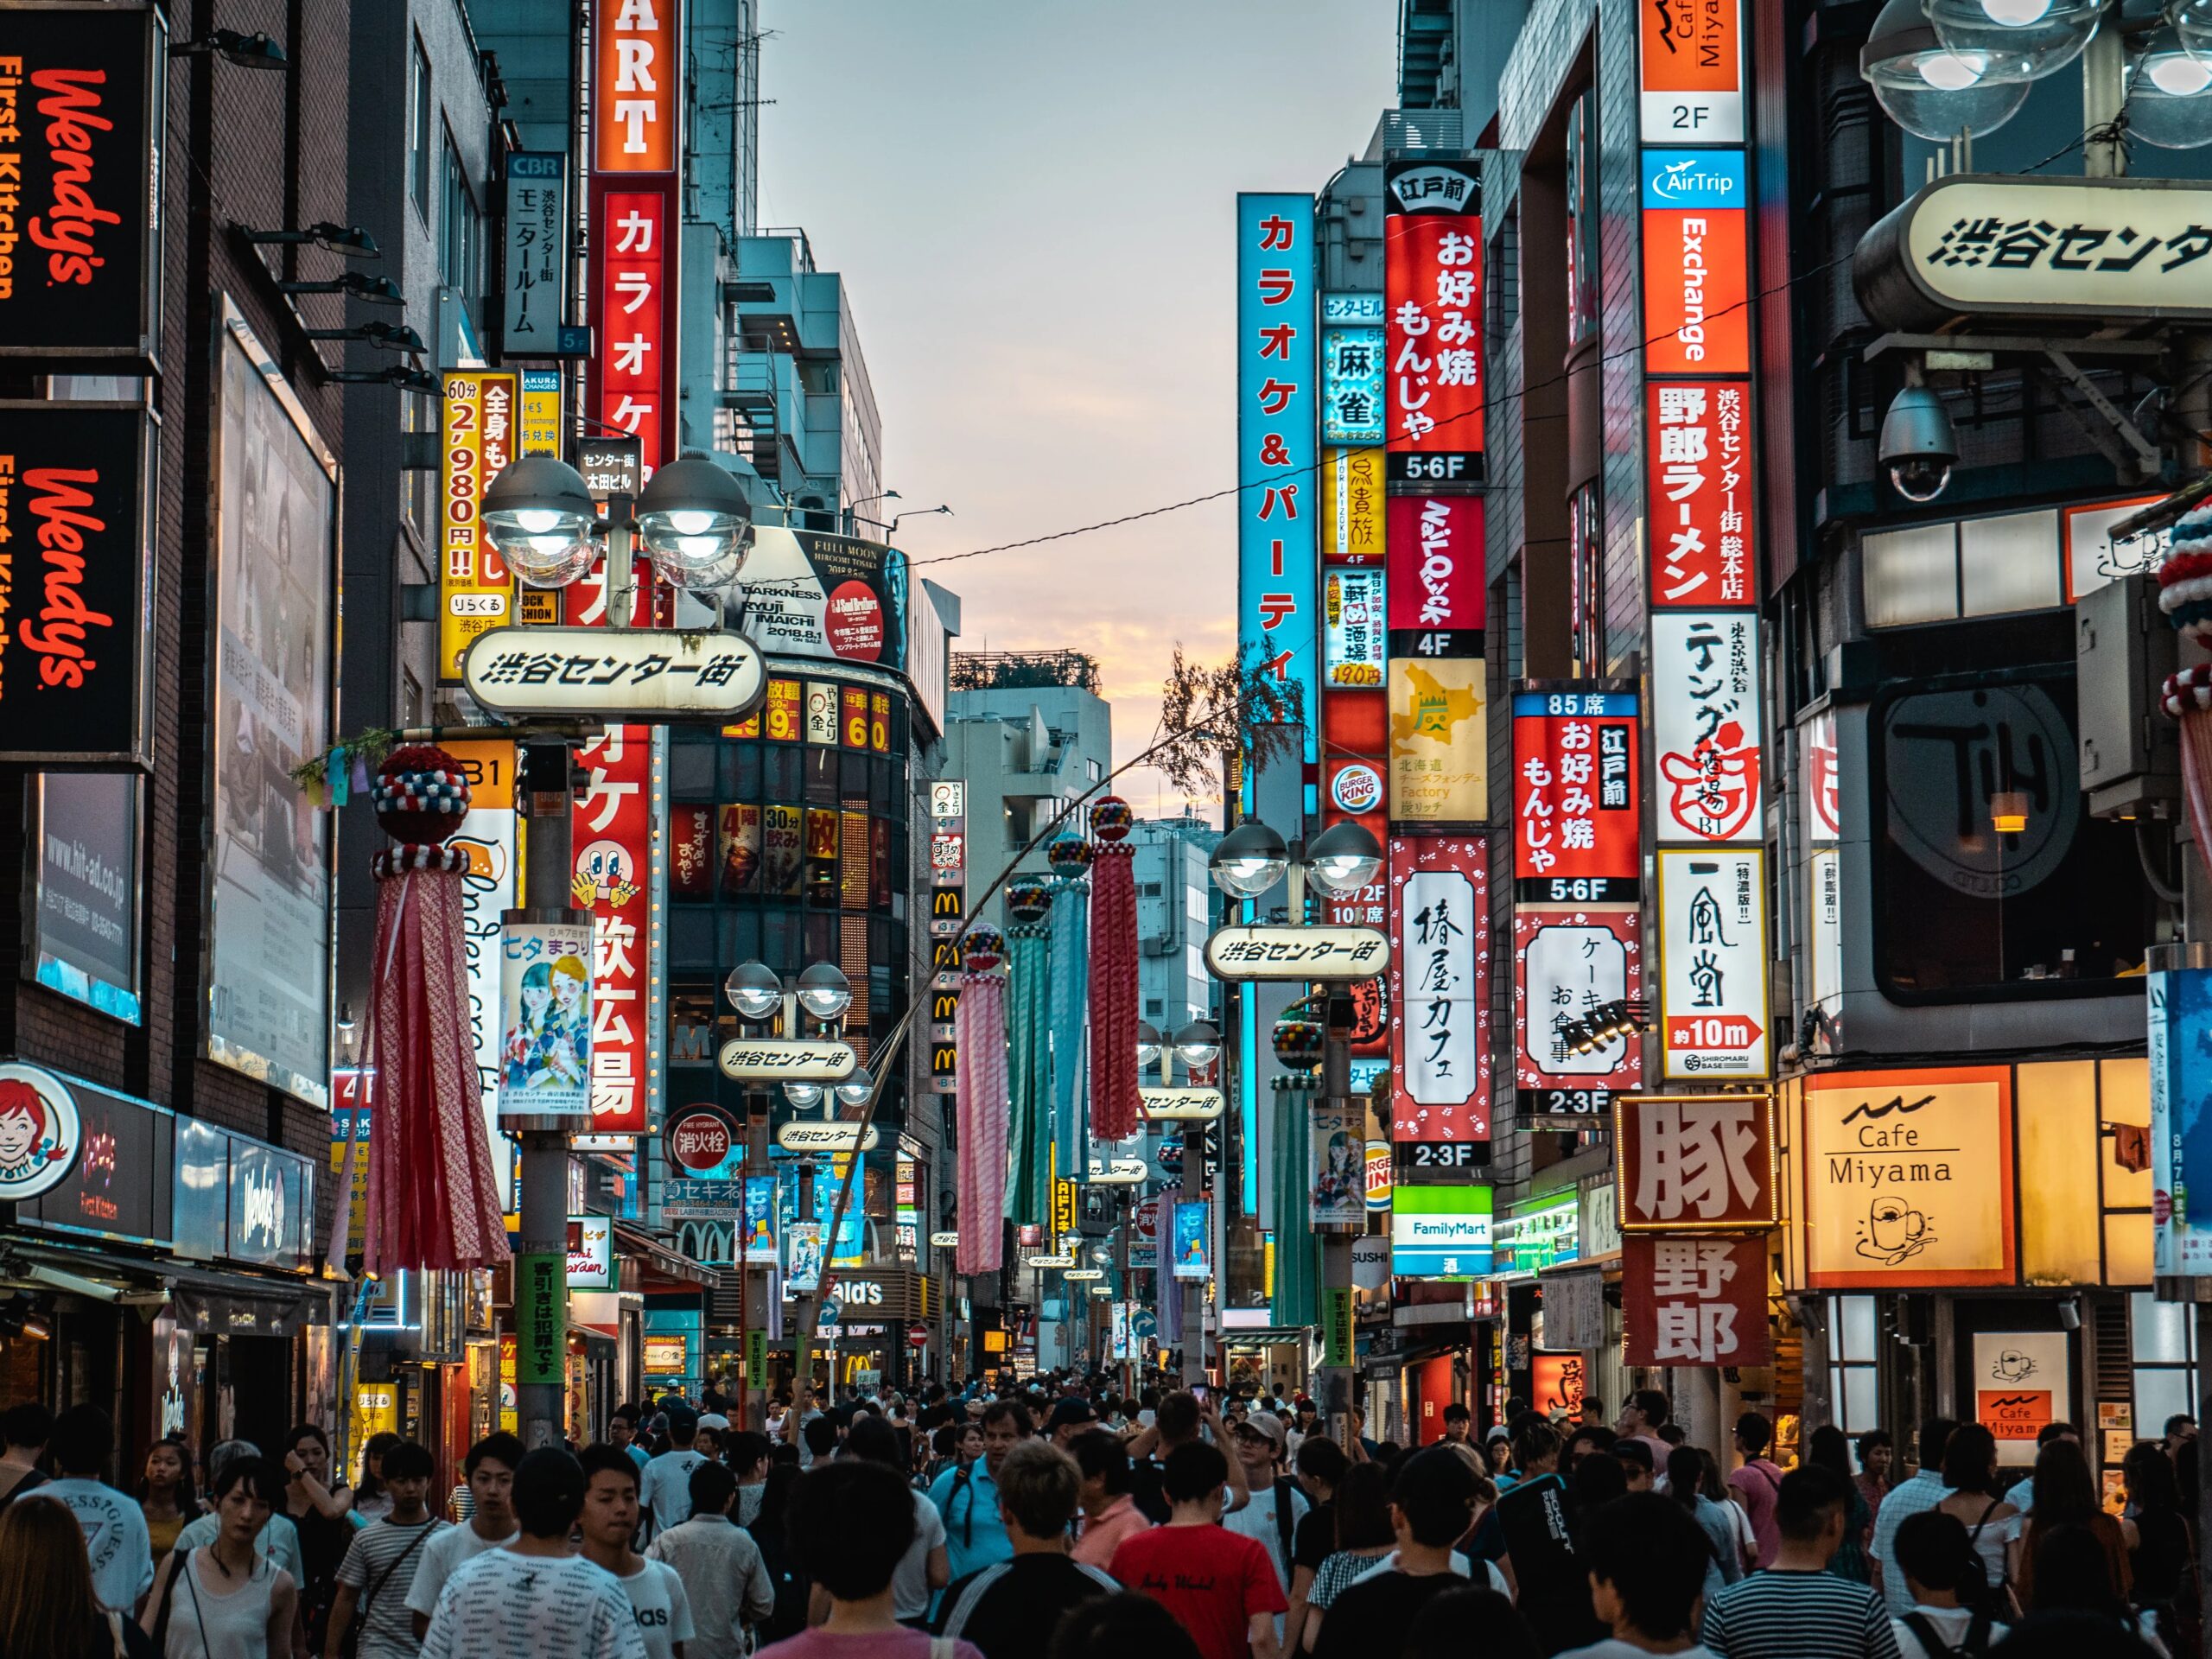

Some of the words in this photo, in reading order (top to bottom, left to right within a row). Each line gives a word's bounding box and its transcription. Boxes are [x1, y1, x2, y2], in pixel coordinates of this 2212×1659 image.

[1673, 105, 1709, 129] 2F
[513, 158, 557, 175] CBR
[29, 69, 120, 287] Wendy's
[1398, 178, 1466, 200] 江戸前
[1667, 173, 1733, 196] AirTrip
[539, 189, 556, 283] 渋谷センター街
[514, 188, 536, 334] モニタールーム
[1678, 218, 1708, 361] Exchange
[1324, 299, 1383, 317] センタービル
[1436, 232, 1478, 387] お好み焼
[448, 380, 477, 399] 60分
[1338, 345, 1371, 424] 麻雀
[583, 454, 635, 468] センター街
[1351, 458, 1374, 546] 鳥貴族
[1658, 387, 1709, 601] 野郎ラーメン
[815, 540, 844, 554] FULL
[848, 545, 877, 560] MOON
[1346, 556, 1364, 564] 4F
[1719, 535, 1744, 600] 総本店
[19, 468, 112, 690] Wendy's
[524, 595, 544, 606] OCK
[741, 586, 822, 601] DARKNESS
[454, 599, 500, 612] りらくる
[522, 608, 551, 620] SHION
[1343, 574, 1369, 662] 一軒め酒場
[766, 627, 822, 639] 2018.8.1
[1419, 633, 1451, 655] 4F
[1731, 621, 1749, 693] 東京渋谷
[479, 652, 748, 688] 渋谷センター街
[1333, 665, 1381, 684] 190円
[826, 687, 837, 741] やきとり
[1548, 694, 1605, 715] 85席
[810, 715, 824, 732] 金
[1399, 760, 1442, 772] 北海道
[1601, 728, 1627, 806] 江戸前
[1339, 776, 1374, 789] BURGER
[1402, 786, 1450, 799] Factory
[1560, 721, 1595, 850] お好み焼
[1341, 786, 1375, 802] KING
[938, 801, 950, 814] 金
[766, 810, 799, 829] 30分
[766, 830, 799, 848] 飲み
[807, 812, 836, 855] 放
[1688, 862, 1738, 1007] 一風堂
[502, 930, 543, 962] 七夕
[548, 938, 589, 957] まつり
[1218, 941, 1381, 963] 渋谷センター街
[1581, 937, 1601, 1011] ケーキ
[727, 1052, 849, 1067] 渋谷センター街
[679, 1131, 726, 1154] 消火栓
[1859, 1123, 1919, 1148] Cafe
[1634, 1102, 1760, 1221] 豚
[1829, 1157, 1953, 1189] Miyama
[1413, 1222, 1486, 1237] FamilyMart
[567, 1261, 607, 1276] arden
[1352, 1254, 1388, 1263] SUSHI
[1443, 1257, 1459, 1274] 酒
[1653, 1240, 1738, 1363] 野郎
[533, 1262, 554, 1376] 客引きは犯罪です
[1999, 1408, 2031, 1419] Cafe
